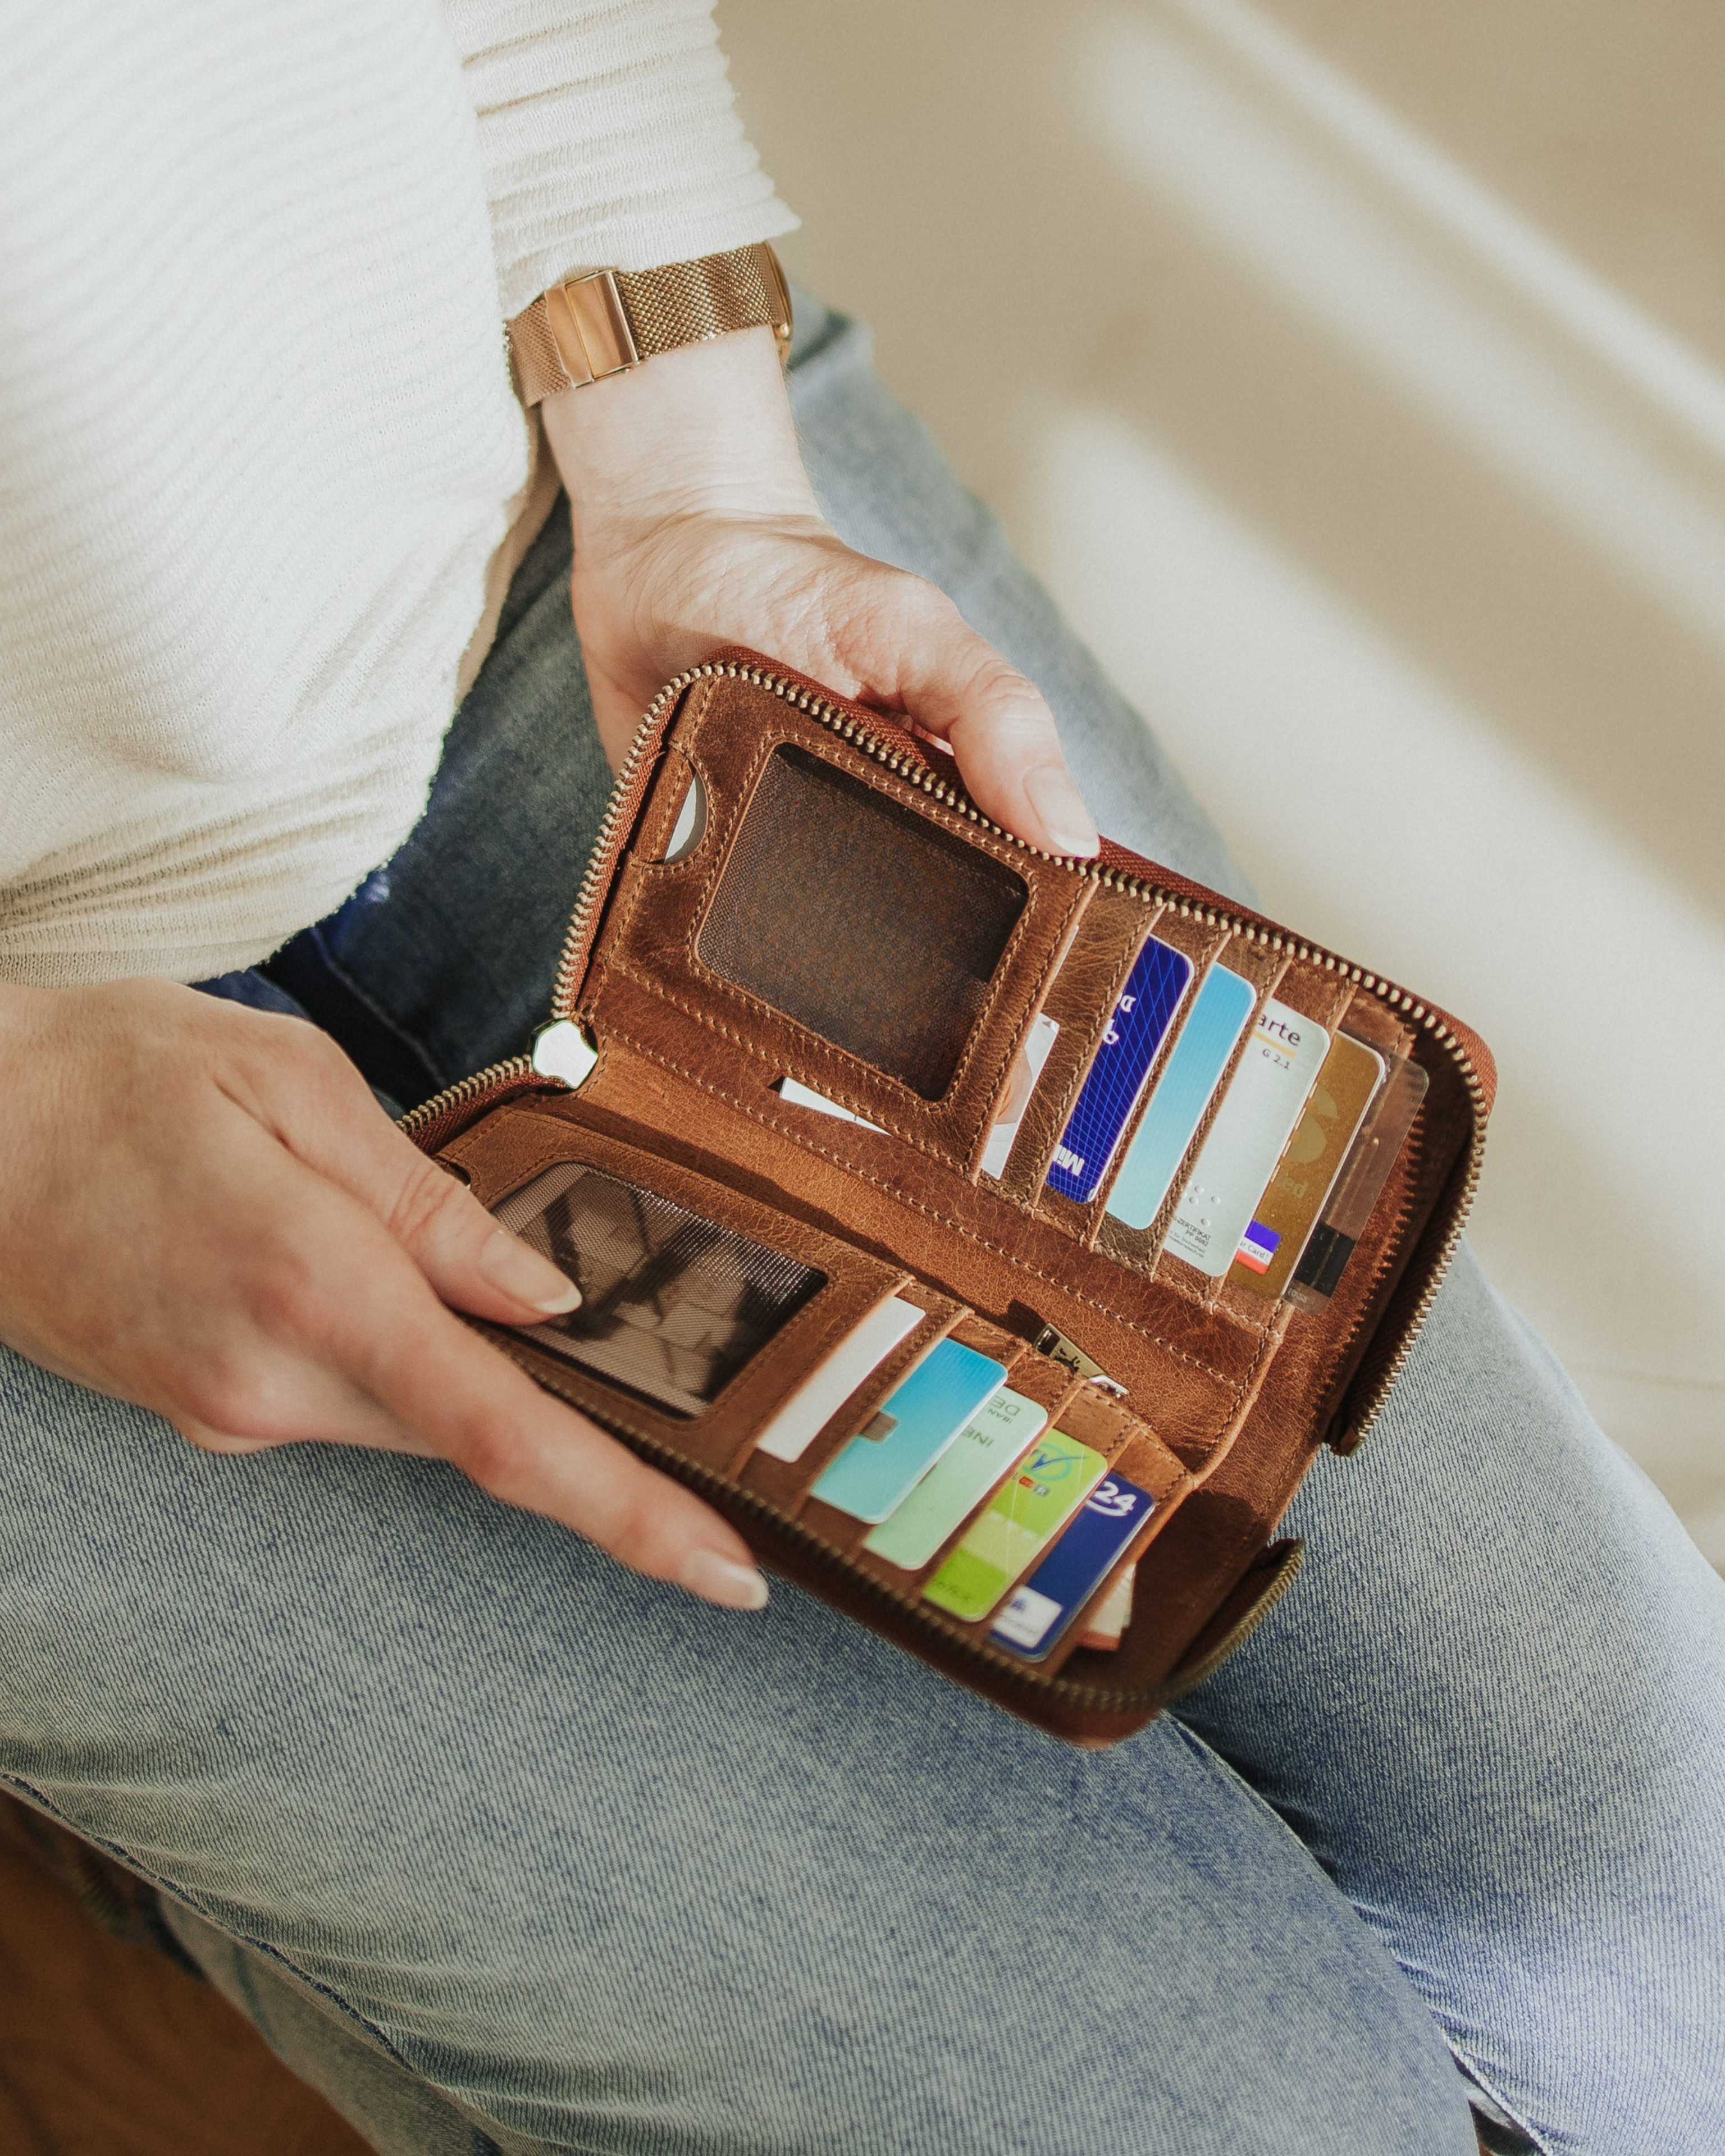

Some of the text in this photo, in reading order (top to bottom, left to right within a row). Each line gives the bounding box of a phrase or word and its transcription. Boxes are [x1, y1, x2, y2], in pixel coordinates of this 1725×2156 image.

[1262, 1048, 1290, 1070] G 2.1
[988, 1409, 1013, 1424] IBAN
[989, 1396, 1020, 1416] DE
[1094, 1481, 1137, 1513] 24
